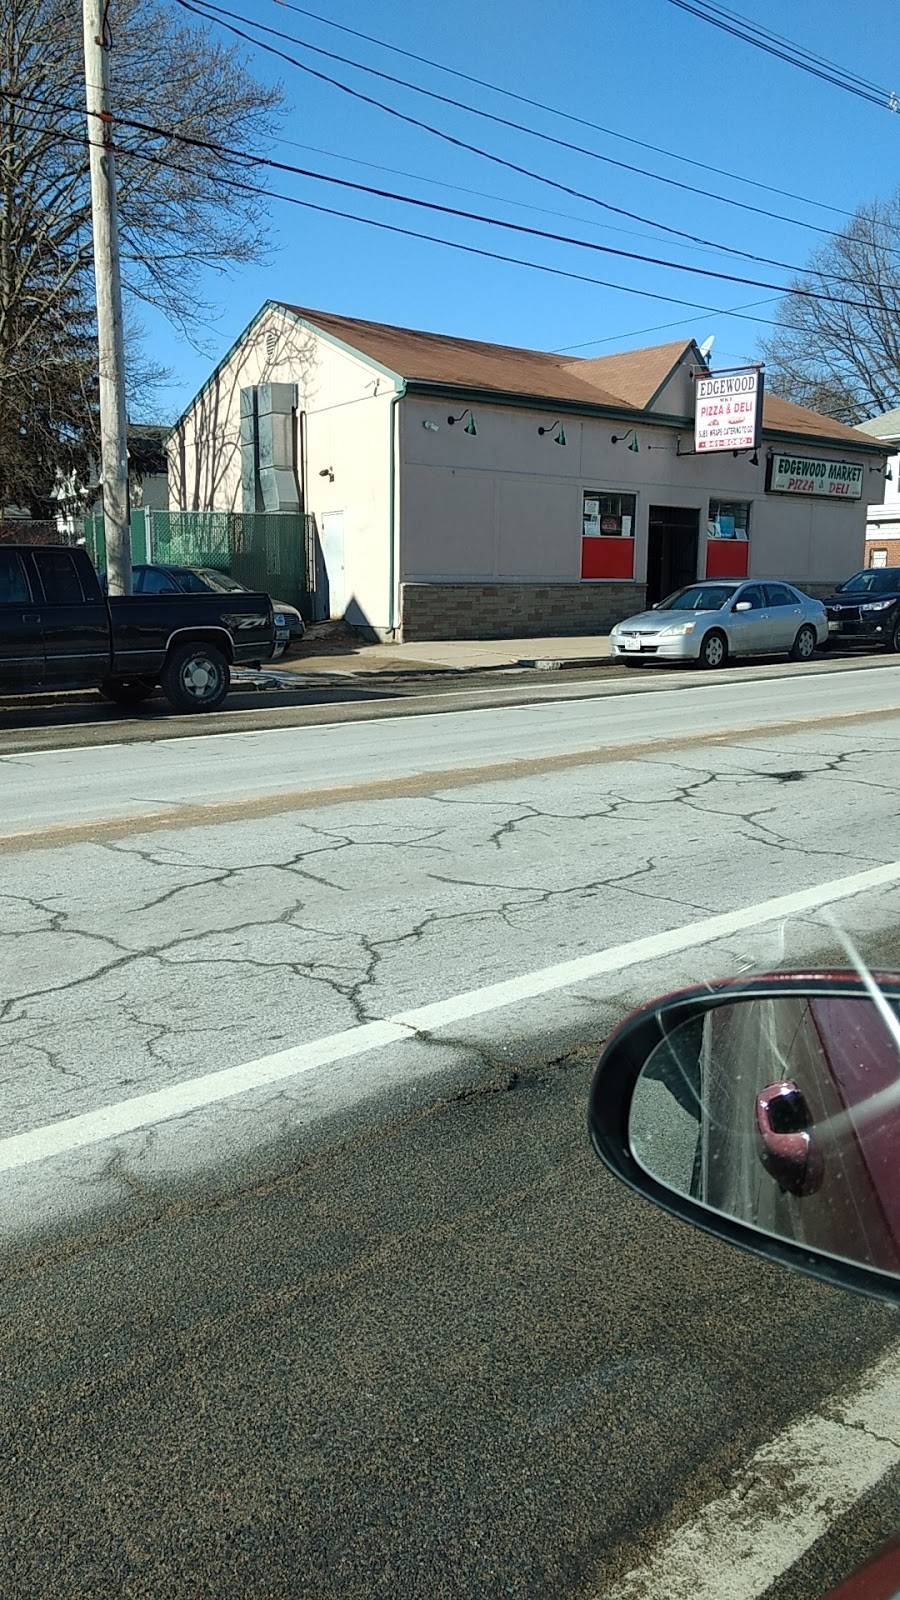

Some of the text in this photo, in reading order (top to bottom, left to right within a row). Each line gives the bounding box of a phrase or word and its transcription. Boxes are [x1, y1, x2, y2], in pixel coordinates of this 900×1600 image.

[700, 377, 754, 396] EDGEWOOD
[701, 402, 753, 416] PIZZA & DELI
[778, 459, 862, 482] EDGEWOOD MARKET
[787, 479, 815, 492] PIZZA
[829, 482, 850, 494] DELI
